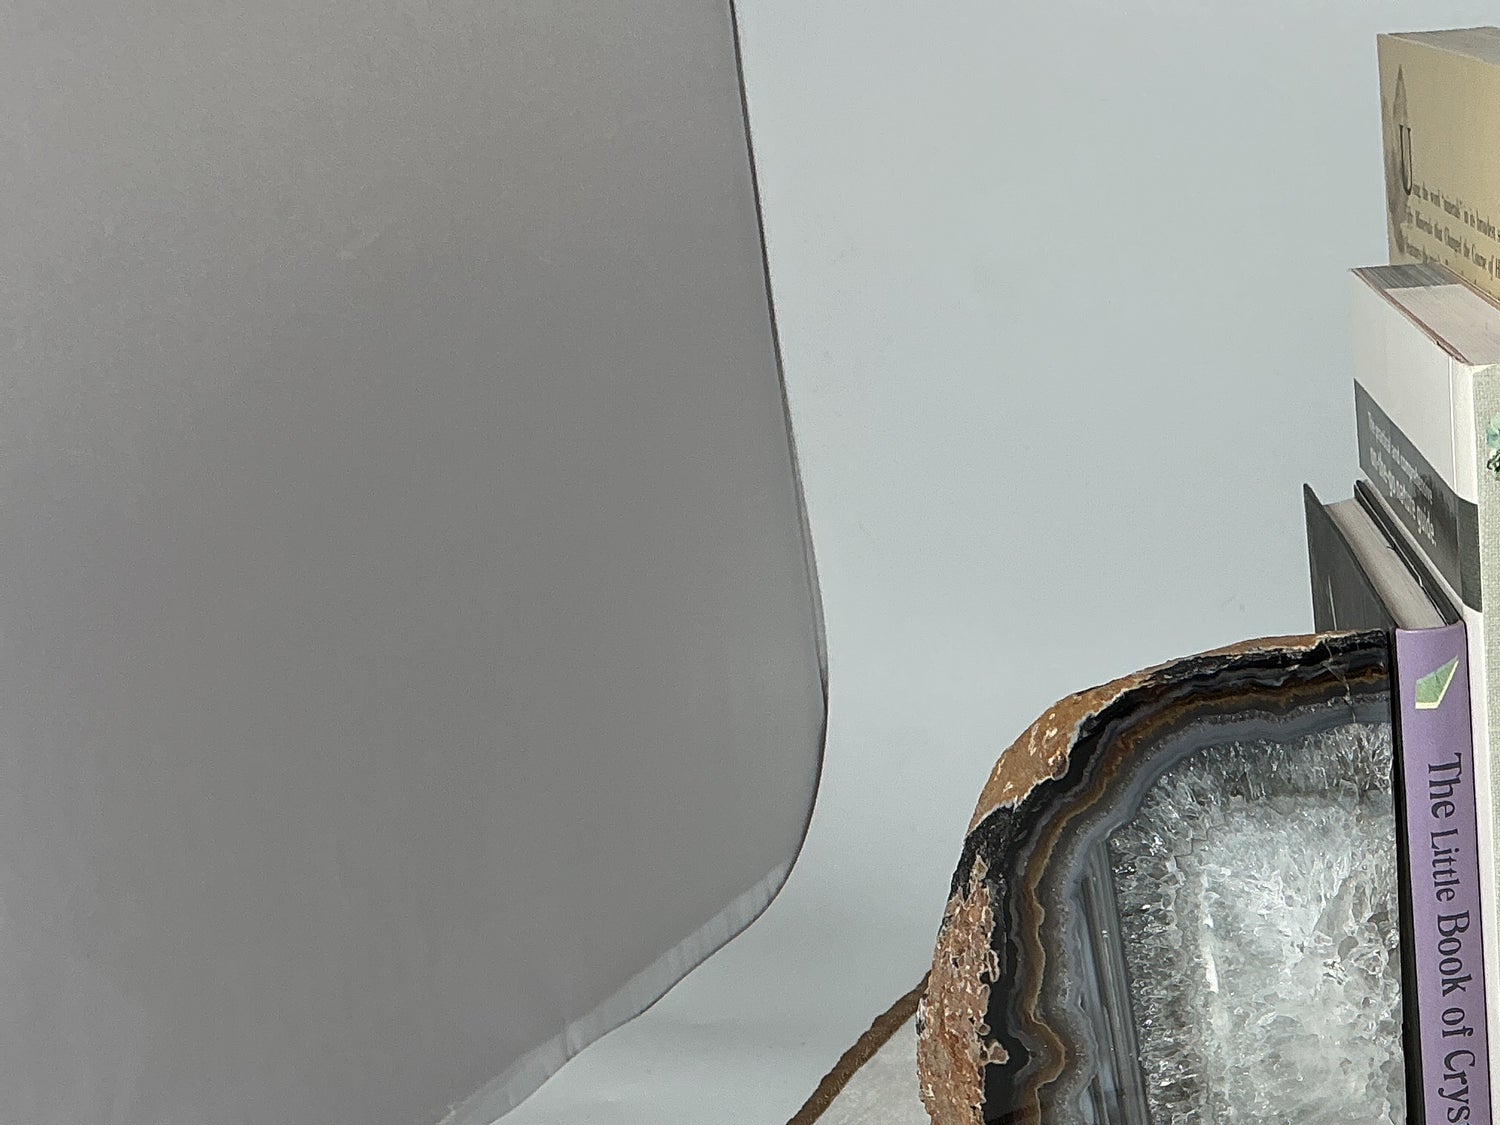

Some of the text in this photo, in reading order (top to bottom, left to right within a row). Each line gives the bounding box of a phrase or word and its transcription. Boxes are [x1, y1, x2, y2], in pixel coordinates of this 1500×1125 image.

[1428, 752, 1462, 820] The
[1430, 828, 1461, 902] Little
[1436, 910, 1473, 997] Book
[1441, 1006, 1474, 1038] of
